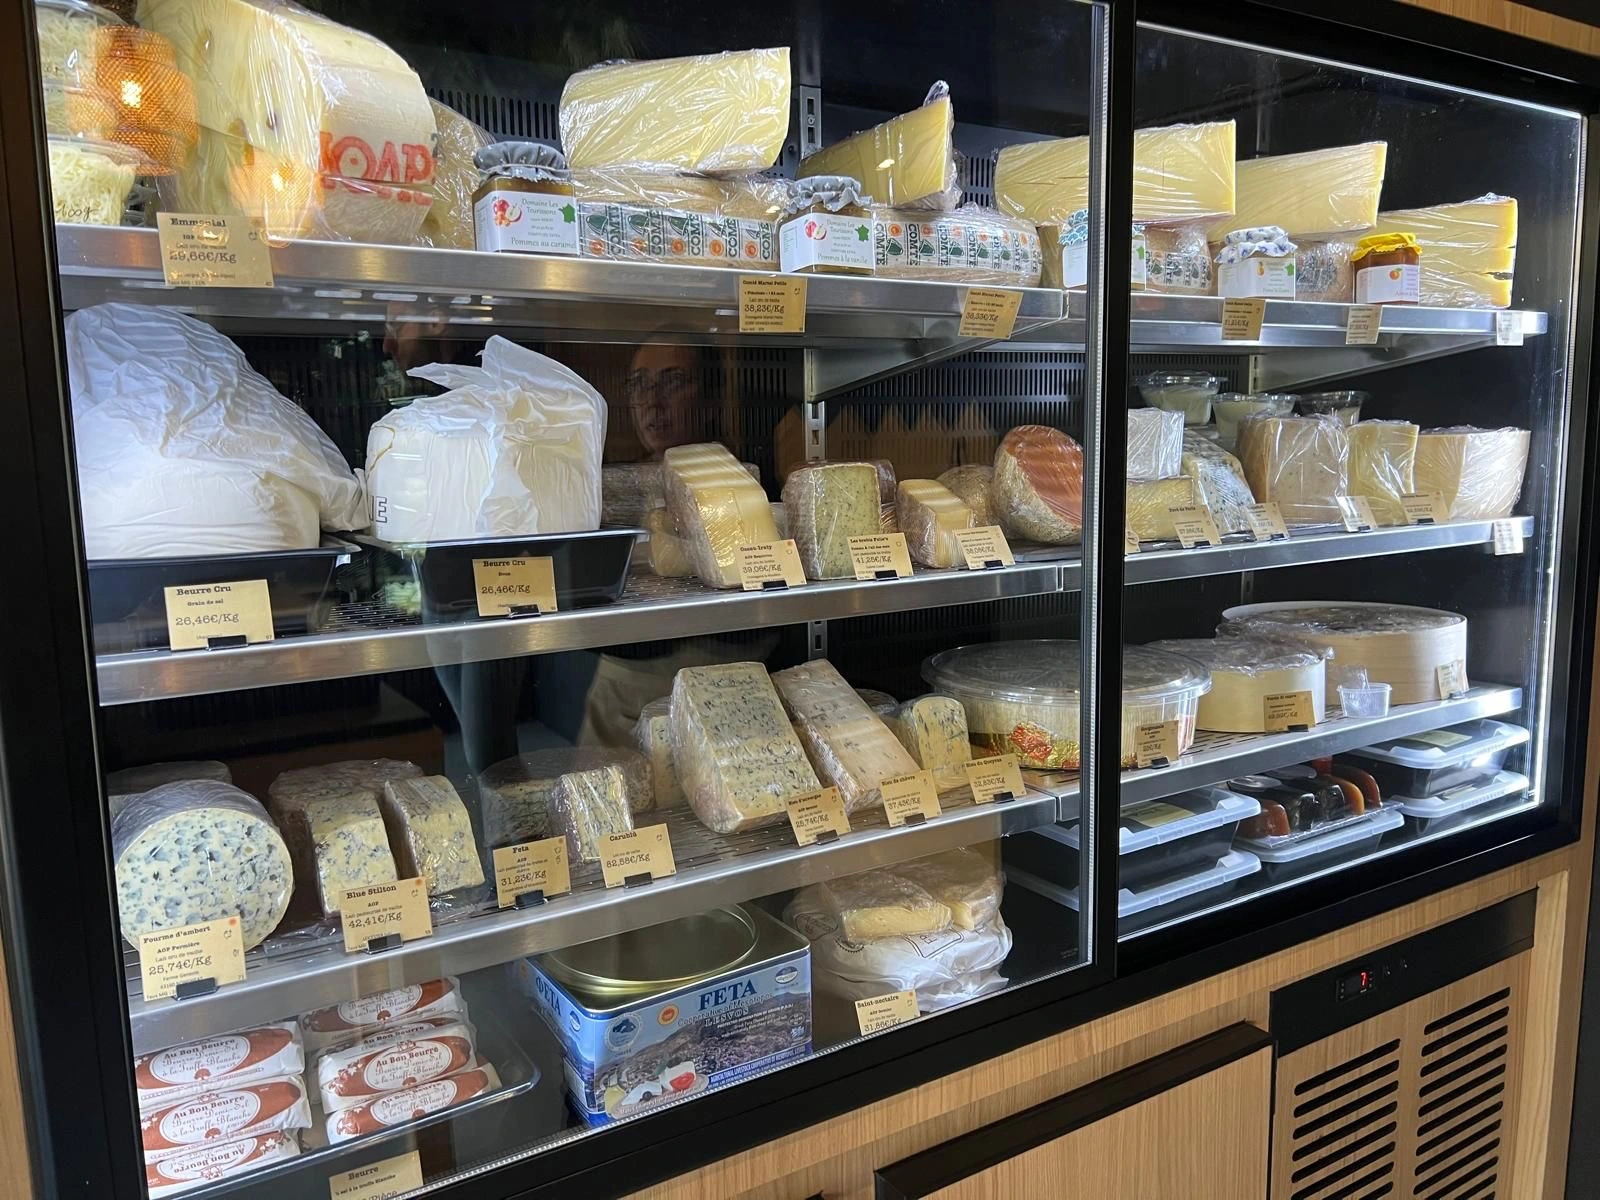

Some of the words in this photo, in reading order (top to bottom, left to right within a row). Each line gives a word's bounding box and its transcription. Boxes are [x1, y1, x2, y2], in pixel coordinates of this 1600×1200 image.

[177, 587, 212, 596] Beurre
[213, 585, 231, 593] Cru
[481, 584, 531, 595] 26,46€/Kg
[175, 613, 240, 627] 26,46€/Kg
[512, 845, 529, 854] Feta
[500, 869, 547, 887] 31,23€/Kg
[346, 890, 366, 899] Blue
[368, 885, 397, 896] Stilton
[348, 911, 402, 928] 42,41€/Kg
[143, 934, 174, 944] Fourme
[175, 925, 211, 937] d'ambert
[148, 955, 213, 976] 25,74€/Kg
[698, 979, 758, 1012] FETA
[857, 994, 900, 1009] Saint-nectaire
[164, 1052, 177, 1060] Au
[179, 1047, 199, 1057] Bon
[201, 1038, 235, 1051] Beurre
[376, 1059, 388, 1068] Au
[389, 1054, 407, 1064] Bon
[408, 1046, 439, 1059] Beurre
[173, 1110, 187, 1121] Au
[188, 1105, 209, 1116] Bon
[210, 1094, 245, 1110] Beurre
[214, 1152, 231, 1163] Bon
[232, 1147, 245, 1157] Au
[173, 1159, 209, 1174] Beurre
[348, 1166, 379, 1180] Beurre
